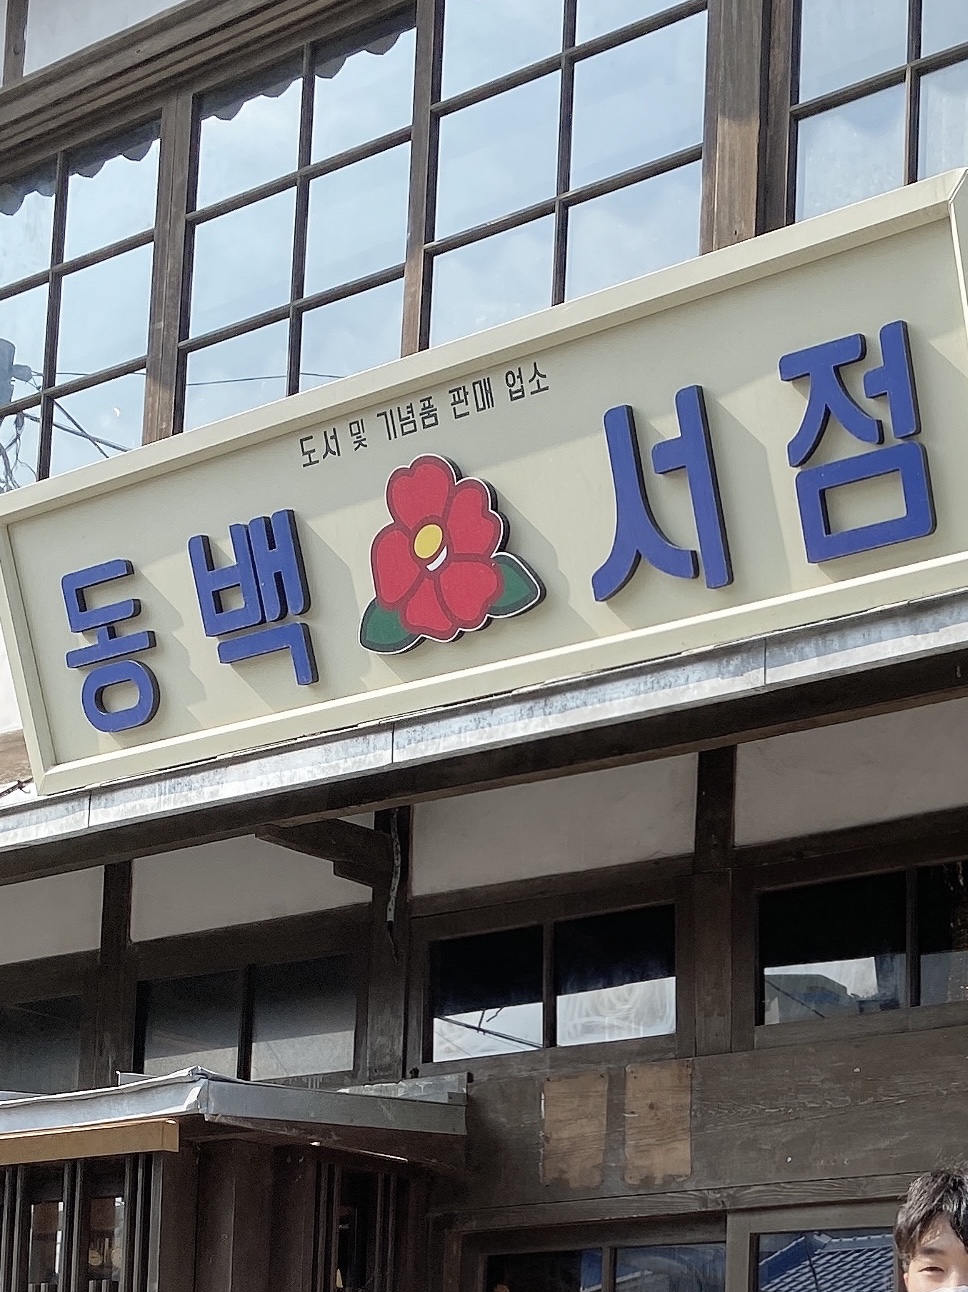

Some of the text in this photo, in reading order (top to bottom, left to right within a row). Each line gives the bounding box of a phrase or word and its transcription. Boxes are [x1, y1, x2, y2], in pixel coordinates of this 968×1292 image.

[61, 319, 937, 734] 동백 서점
[299, 361, 550, 468] 도서 및 기념품 판매 업소
